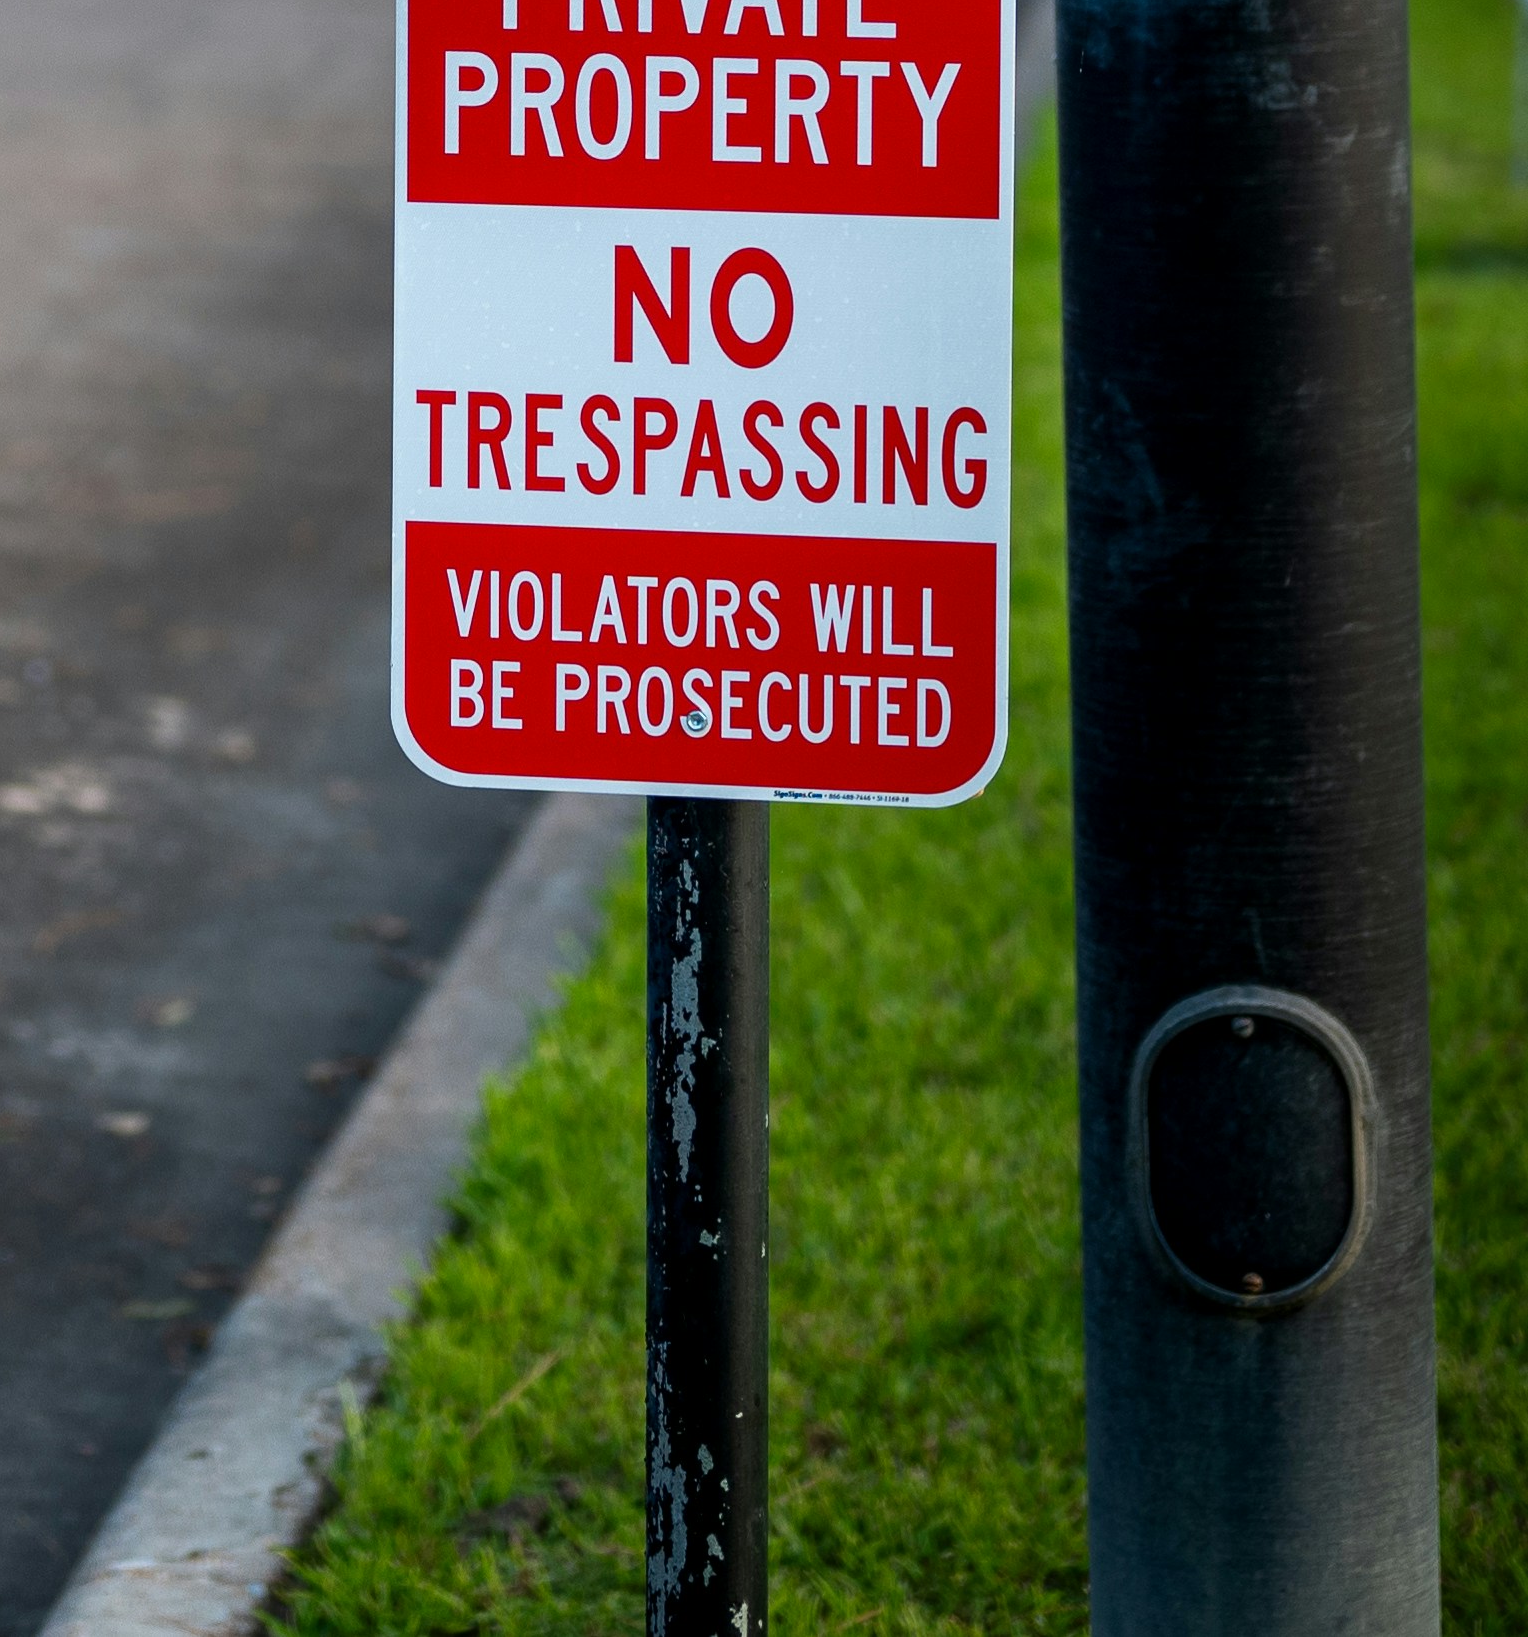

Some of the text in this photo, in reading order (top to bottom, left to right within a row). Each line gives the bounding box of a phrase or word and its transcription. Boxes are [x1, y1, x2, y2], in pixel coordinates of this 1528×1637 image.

[445, 51, 961, 167] PROPERTY
[614, 247, 793, 369] NO
[416, 390, 985, 508] TRESPASSING
[447, 569, 953, 657] VIOLATORS WILL
[451, 659, 951, 747] BE PROSECUTED
